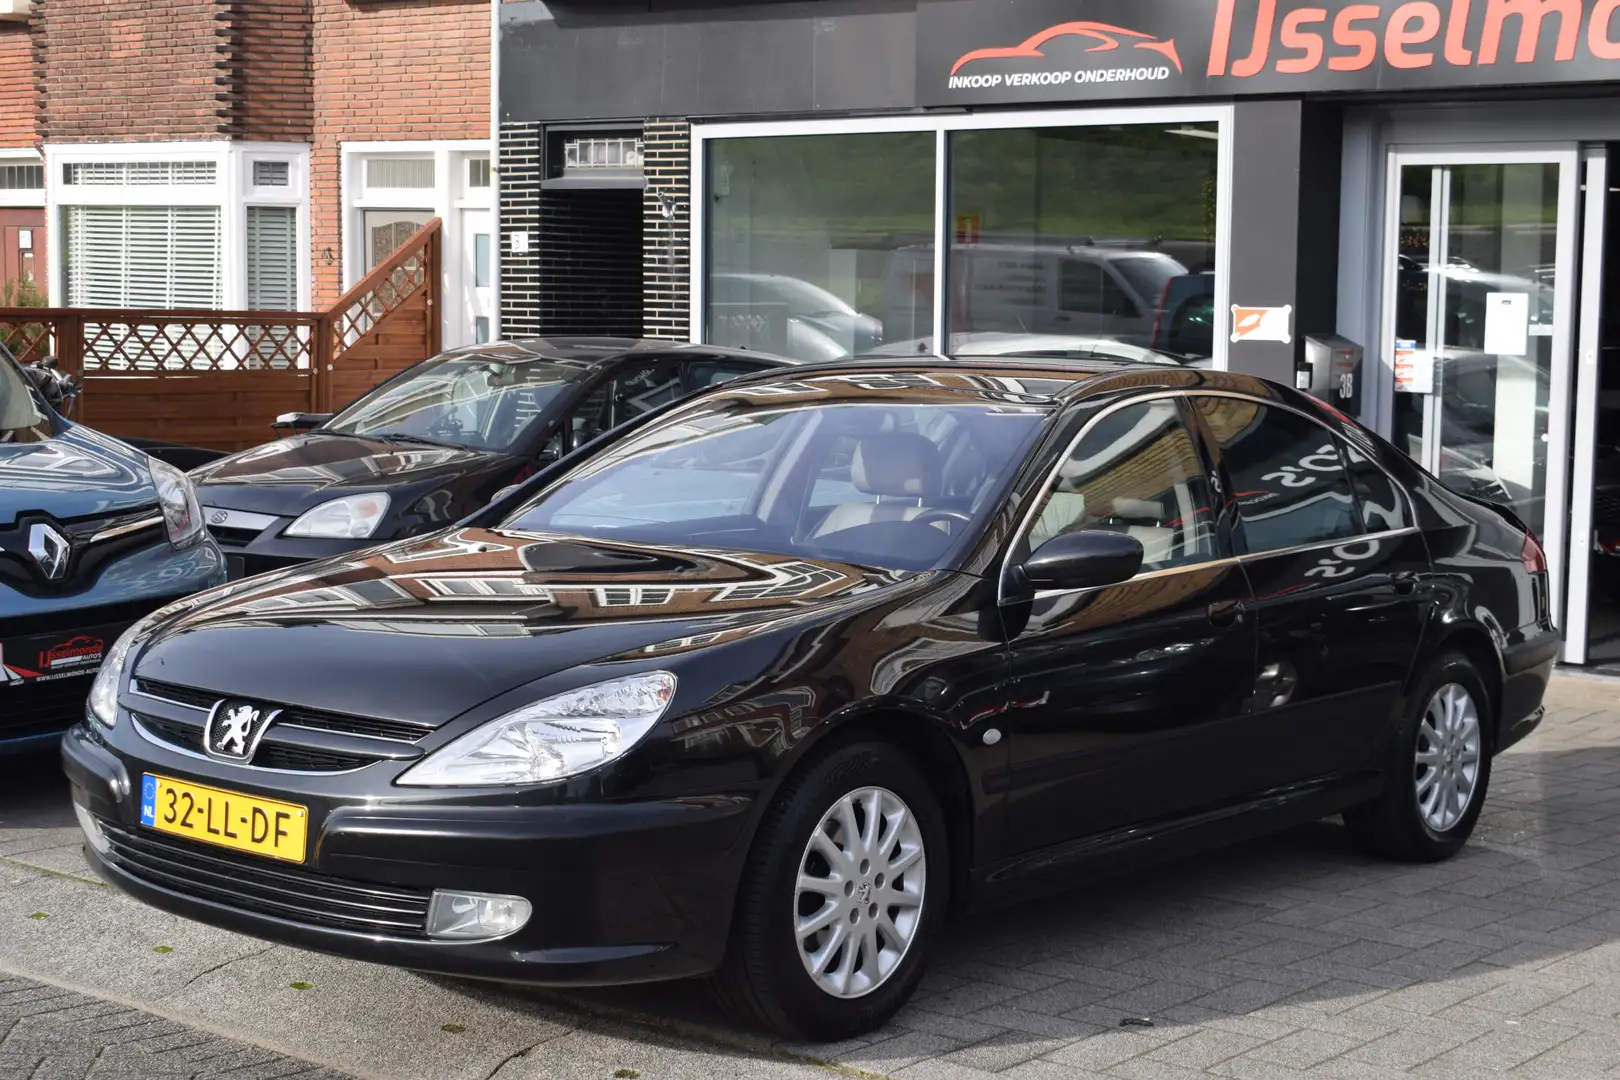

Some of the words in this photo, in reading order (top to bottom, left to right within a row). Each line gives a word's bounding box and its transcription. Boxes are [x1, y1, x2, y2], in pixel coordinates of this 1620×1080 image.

[948, 74, 1002, 89] INKOOP
[1004, 70, 1072, 87] VERKOOP
[1073, 66, 1170, 84] ONDERHOUD
[143, 803, 155, 818] NL
[163, 787, 292, 849] 32-LL-DF
